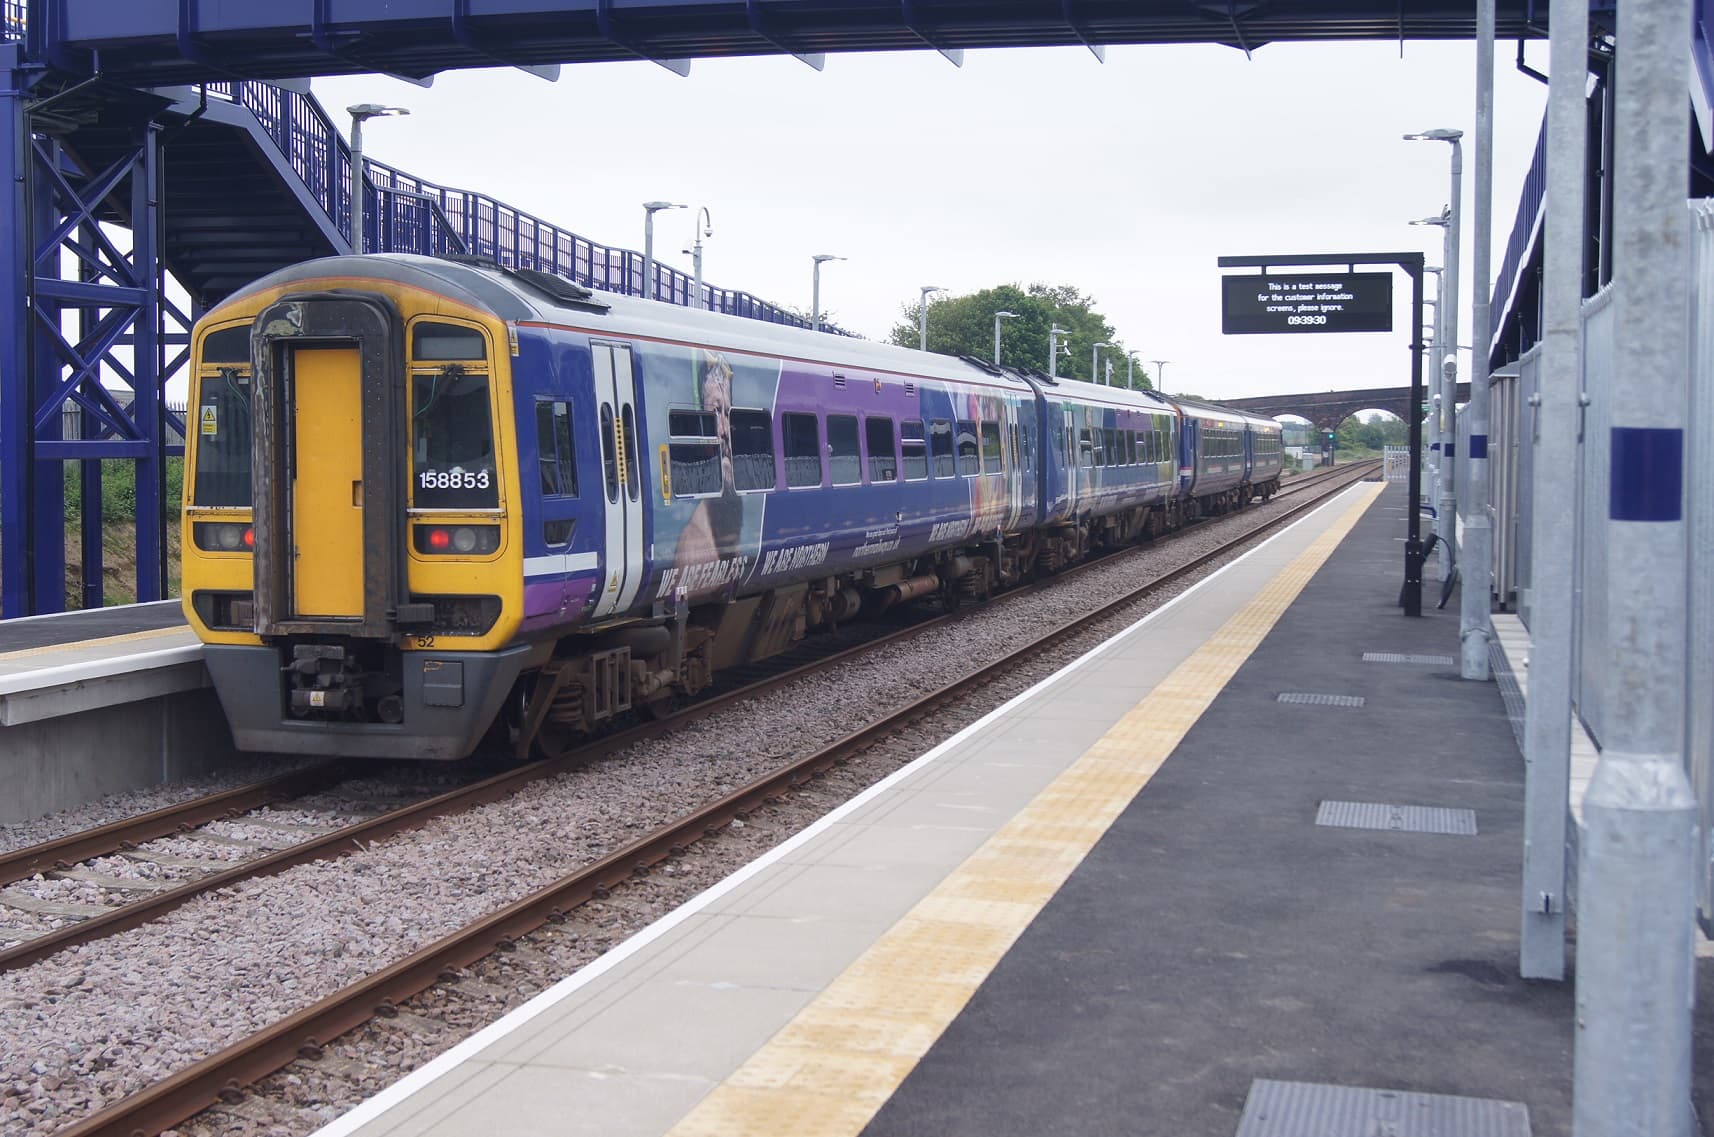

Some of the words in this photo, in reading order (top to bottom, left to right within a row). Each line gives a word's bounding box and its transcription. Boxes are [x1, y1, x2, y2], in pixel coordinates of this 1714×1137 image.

[1268, 283, 1282, 291] This
[1283, 283, 1290, 291] is
[1258, 293, 1270, 302] for
[1271, 293, 1283, 301] the
[1285, 293, 1315, 301] customer
[1266, 305, 1297, 313] screens,
[1298, 303, 1319, 313] please
[1321, 304, 1344, 313] ignore.
[419, 472, 490, 489] 158853
[655, 568, 680, 599] WE
[696, 555, 749, 591] FEARLESS
[416, 635, 435, 648] 52
